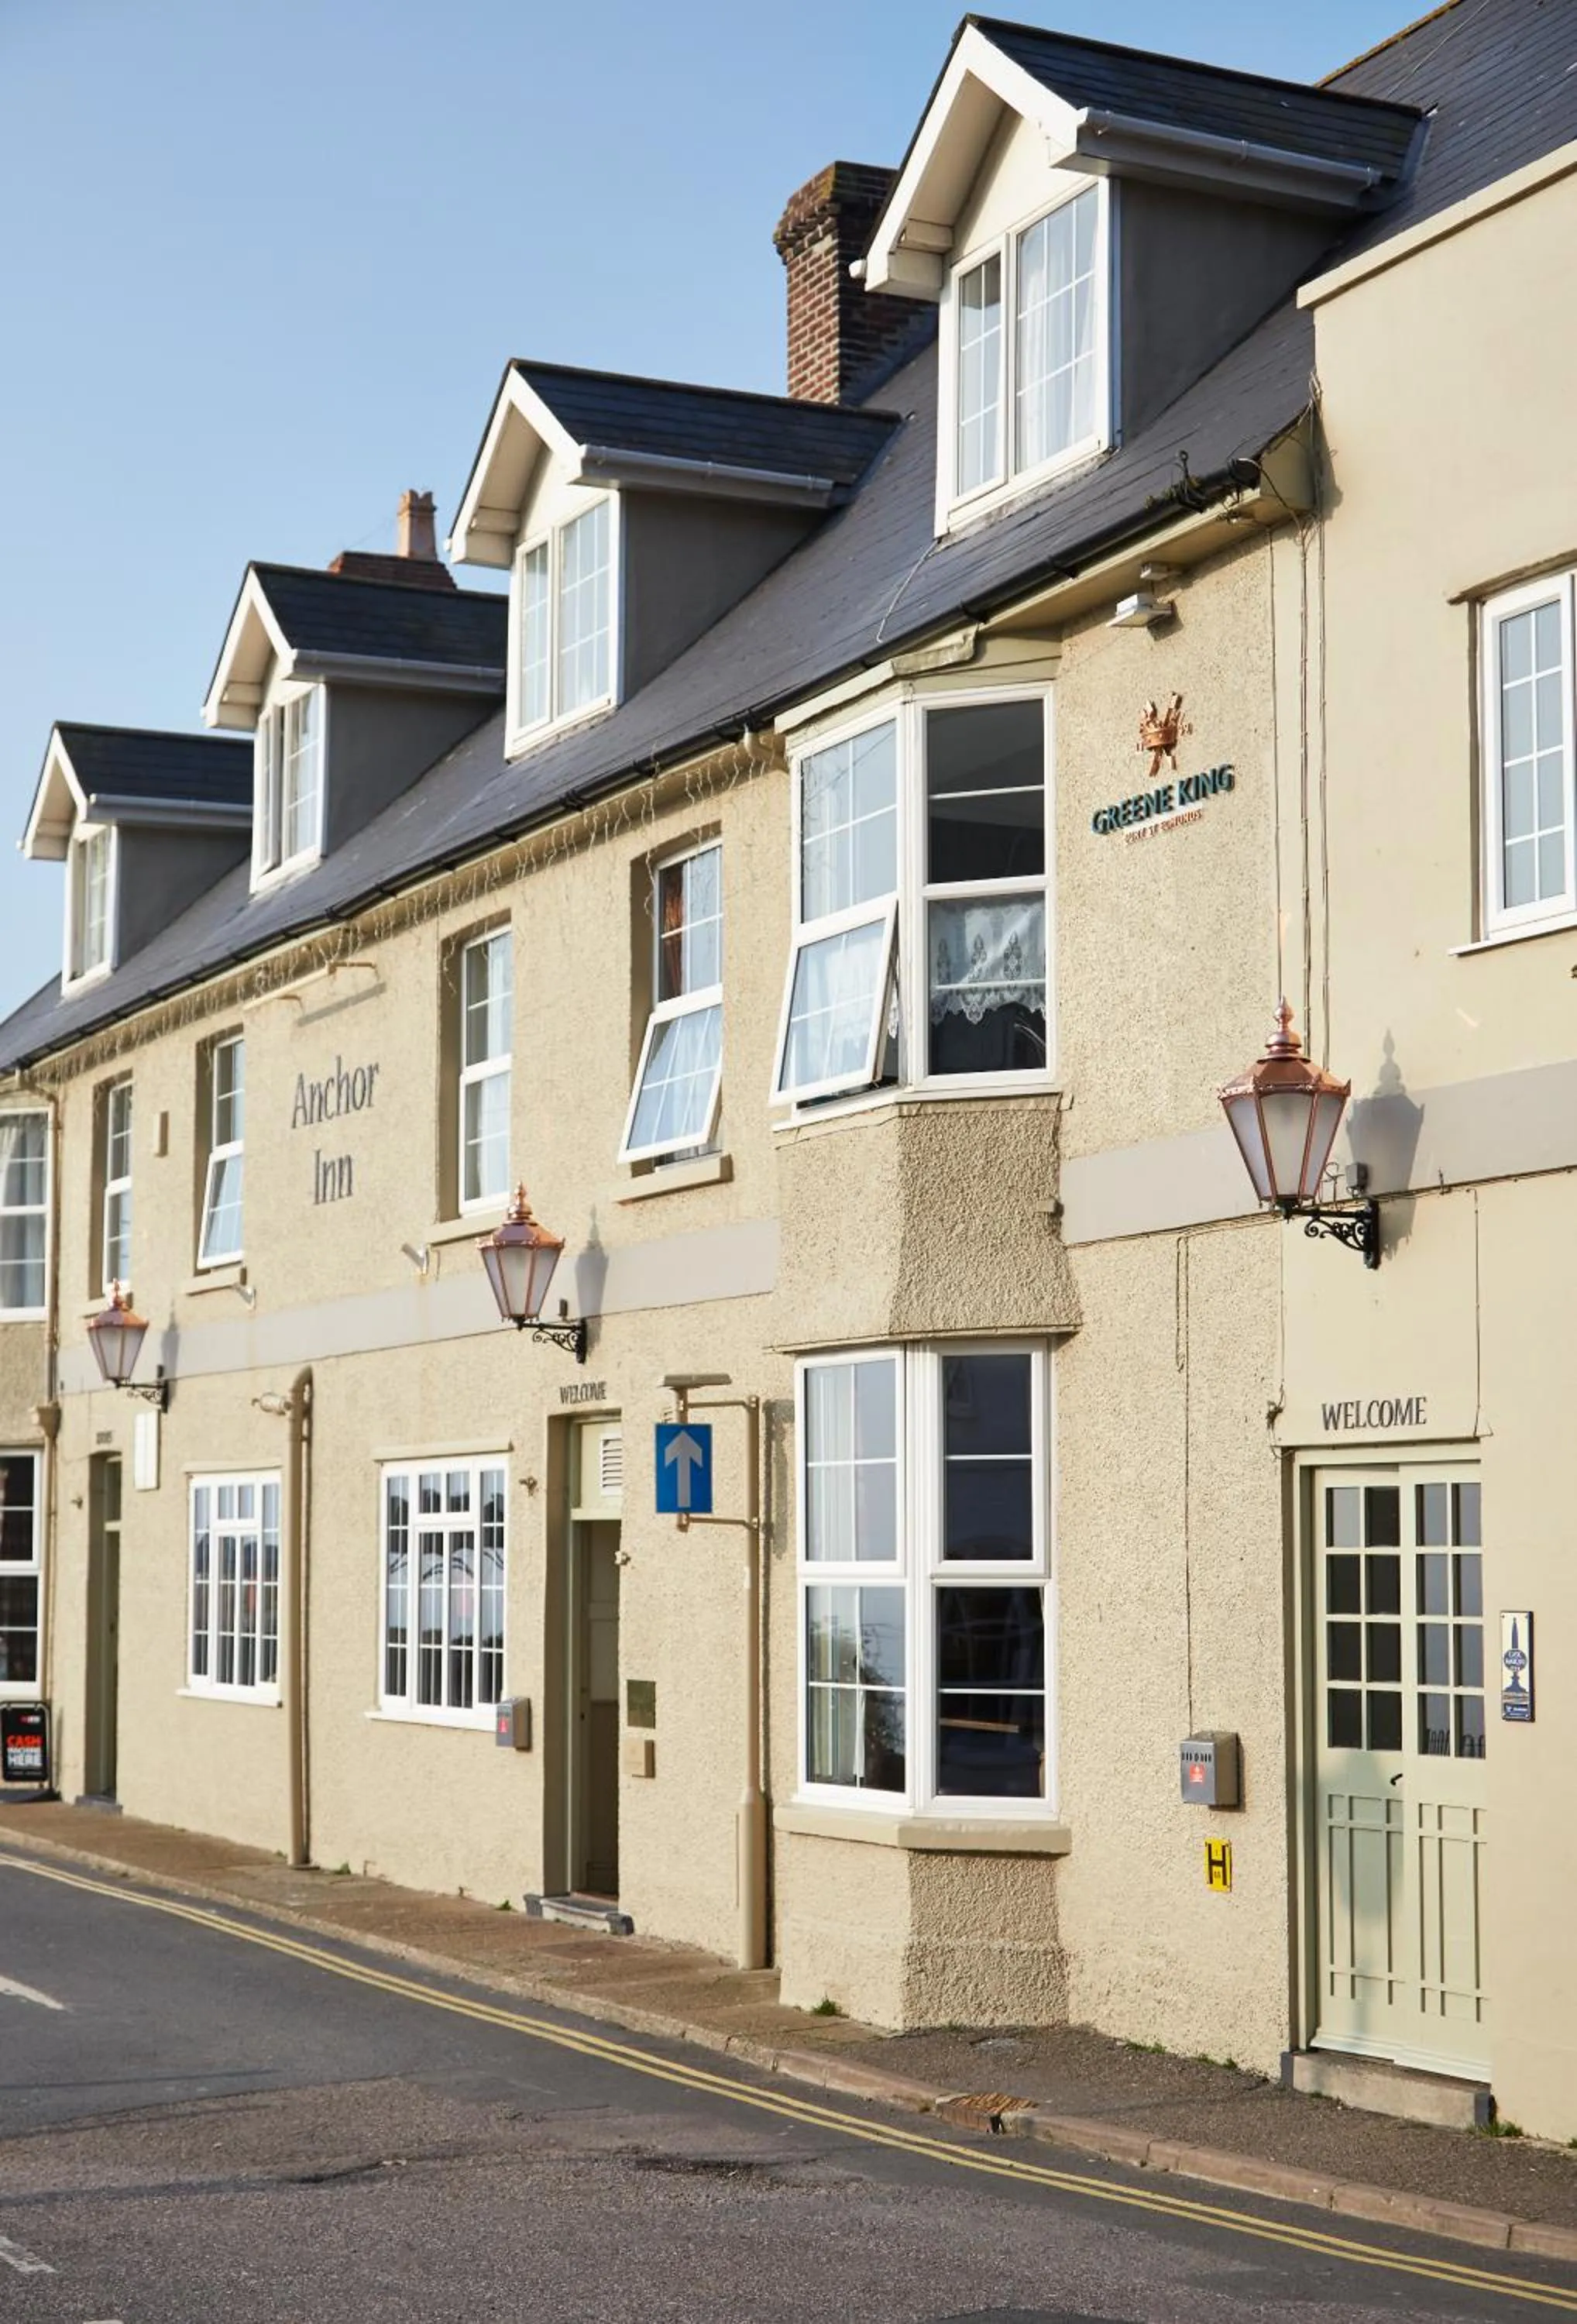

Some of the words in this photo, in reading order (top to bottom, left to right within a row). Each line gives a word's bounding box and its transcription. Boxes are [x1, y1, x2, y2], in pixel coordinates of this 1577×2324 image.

[1091, 785, 1174, 835] GREENE
[1177, 764, 1236, 806] KING
[291, 1054, 380, 1129] Anchor
[313, 1148, 354, 1205] Inn
[559, 1380, 607, 1404] WELCOME
[1321, 1396, 1428, 1432] WELCOME
[6, 1734, 43, 1748] CASH
[7, 1753, 43, 1767] HERE
[1208, 1843, 1227, 1886] H
